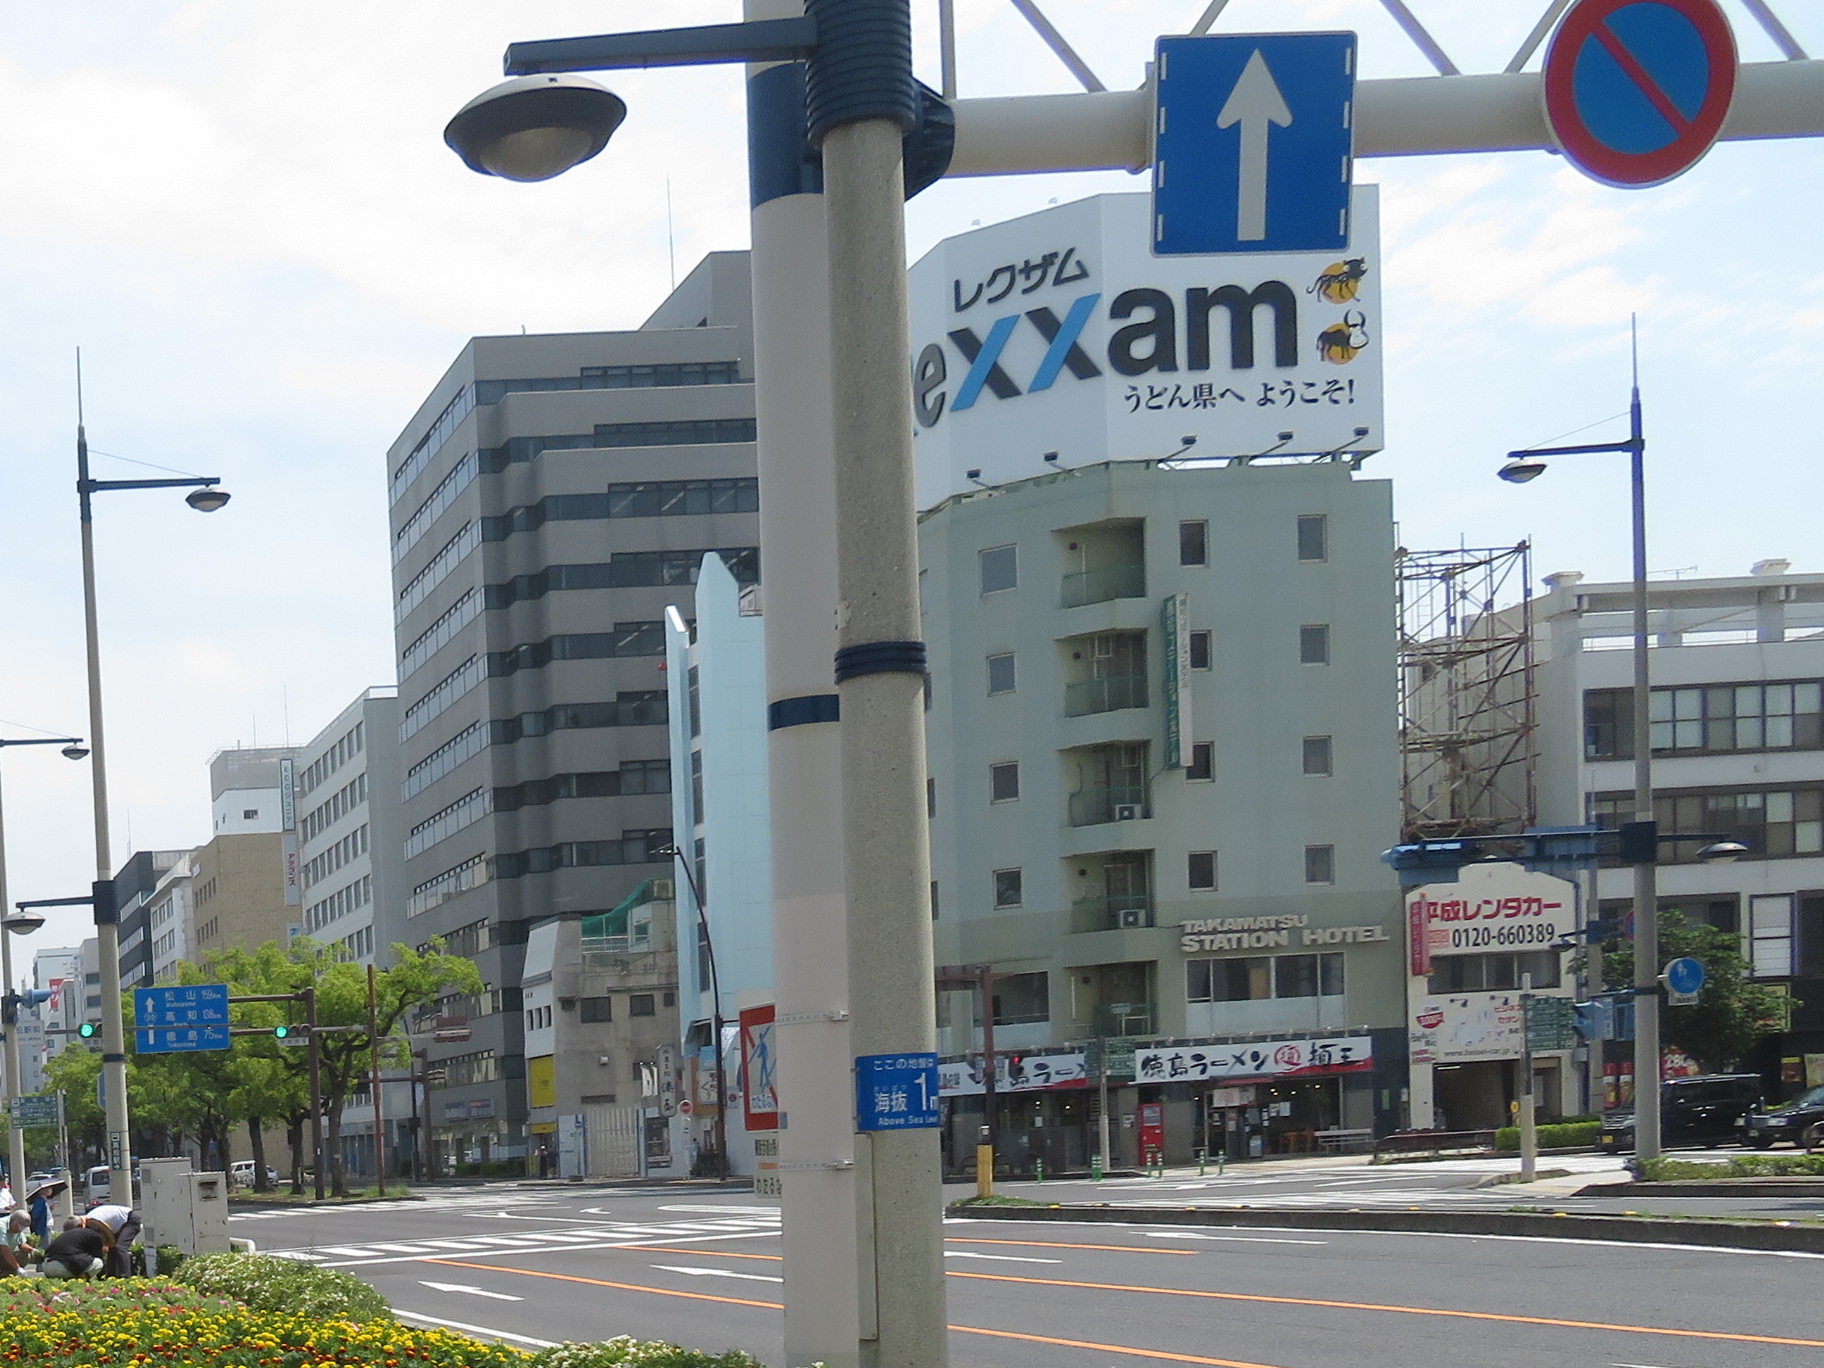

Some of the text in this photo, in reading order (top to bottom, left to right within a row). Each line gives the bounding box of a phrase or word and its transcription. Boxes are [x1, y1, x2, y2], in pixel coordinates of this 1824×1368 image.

[953, 247, 1089, 313] レクザム
[914, 280, 1299, 428] exxam
[1124, 378, 1355, 414] うどん県へ ようこそ!
[1180, 914, 1309, 933] TAKAMATSU
[1452, 923, 1556, 948] 0120-660389
[1181, 925, 1391, 952] STATION HOTEL
[873, 1058, 933, 1071] ここの地盤は
[1141, 1050, 1269, 1079] 徳島ラーメン
[874, 1091, 908, 1113] 海抜
[878, 1117, 905, 1125] Above
[908, 1115, 923, 1124] Sea
